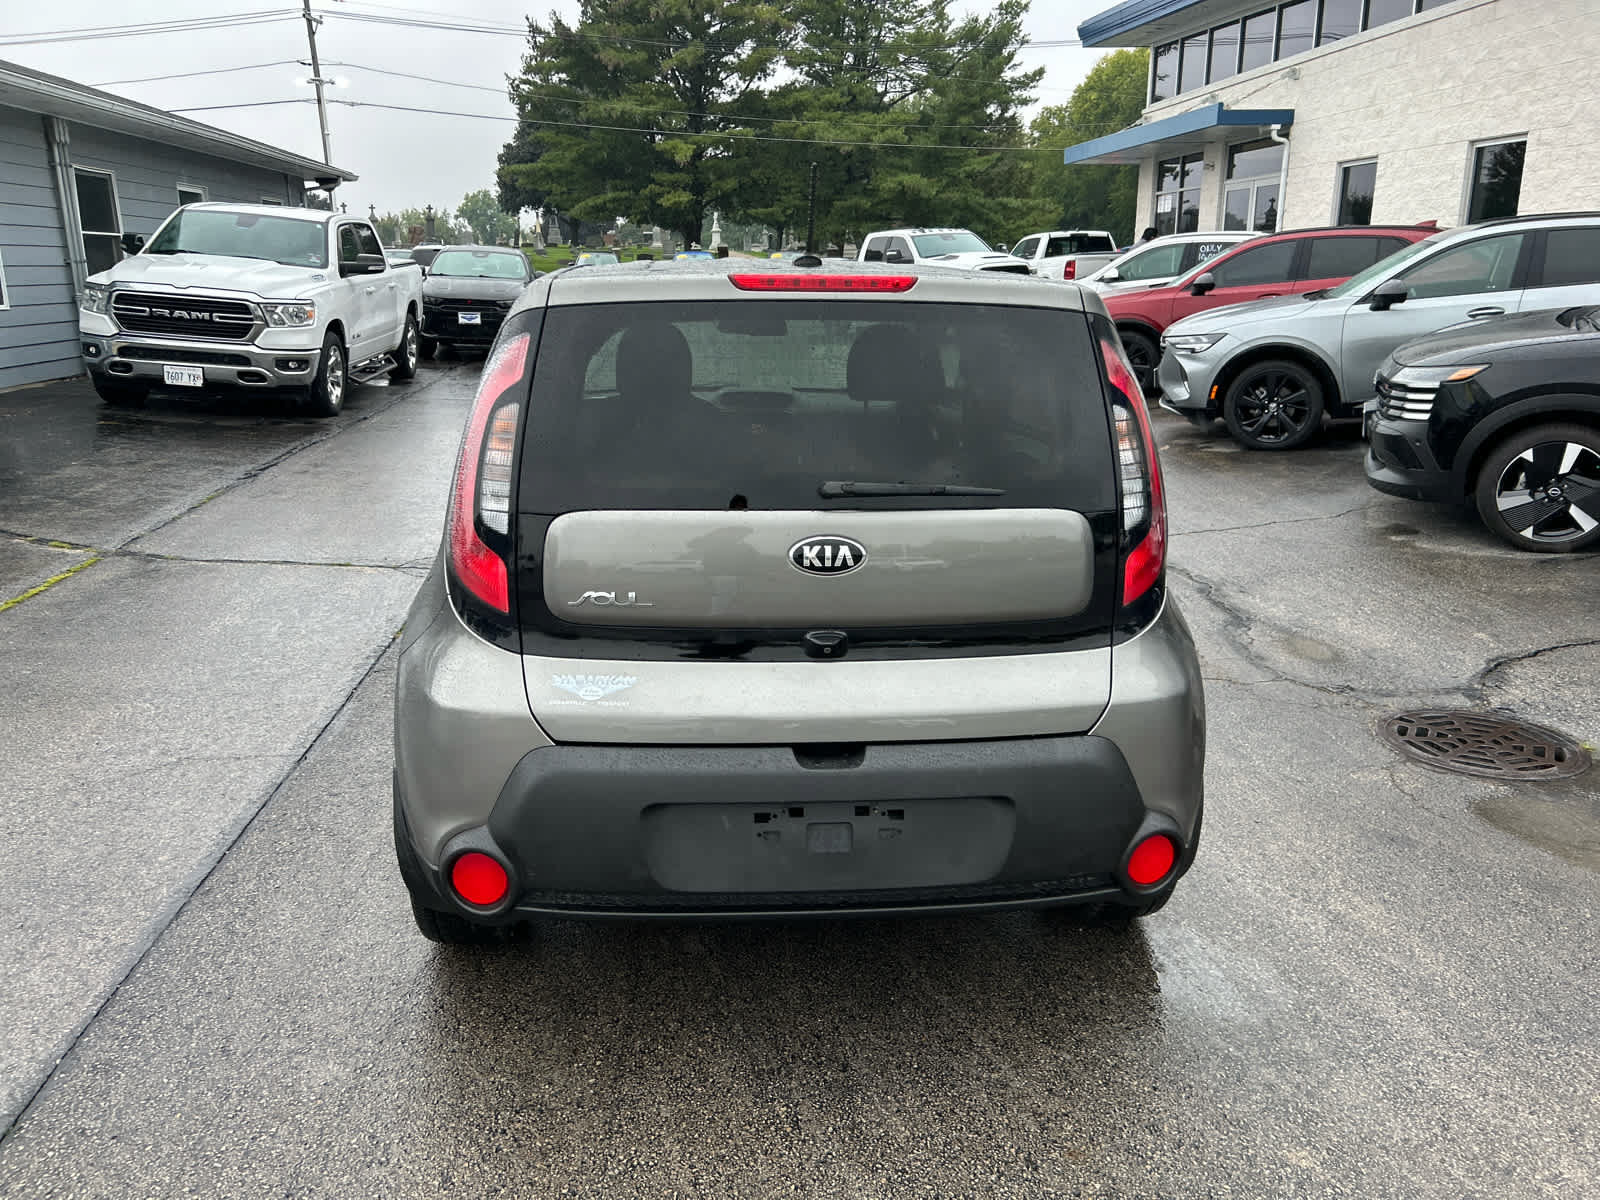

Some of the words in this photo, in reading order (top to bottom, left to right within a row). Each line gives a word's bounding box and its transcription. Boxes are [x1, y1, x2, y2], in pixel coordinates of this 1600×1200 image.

[151, 308, 210, 320] RAM
[802, 545, 855, 567] KIA
[568, 591, 653, 607] SOUL
